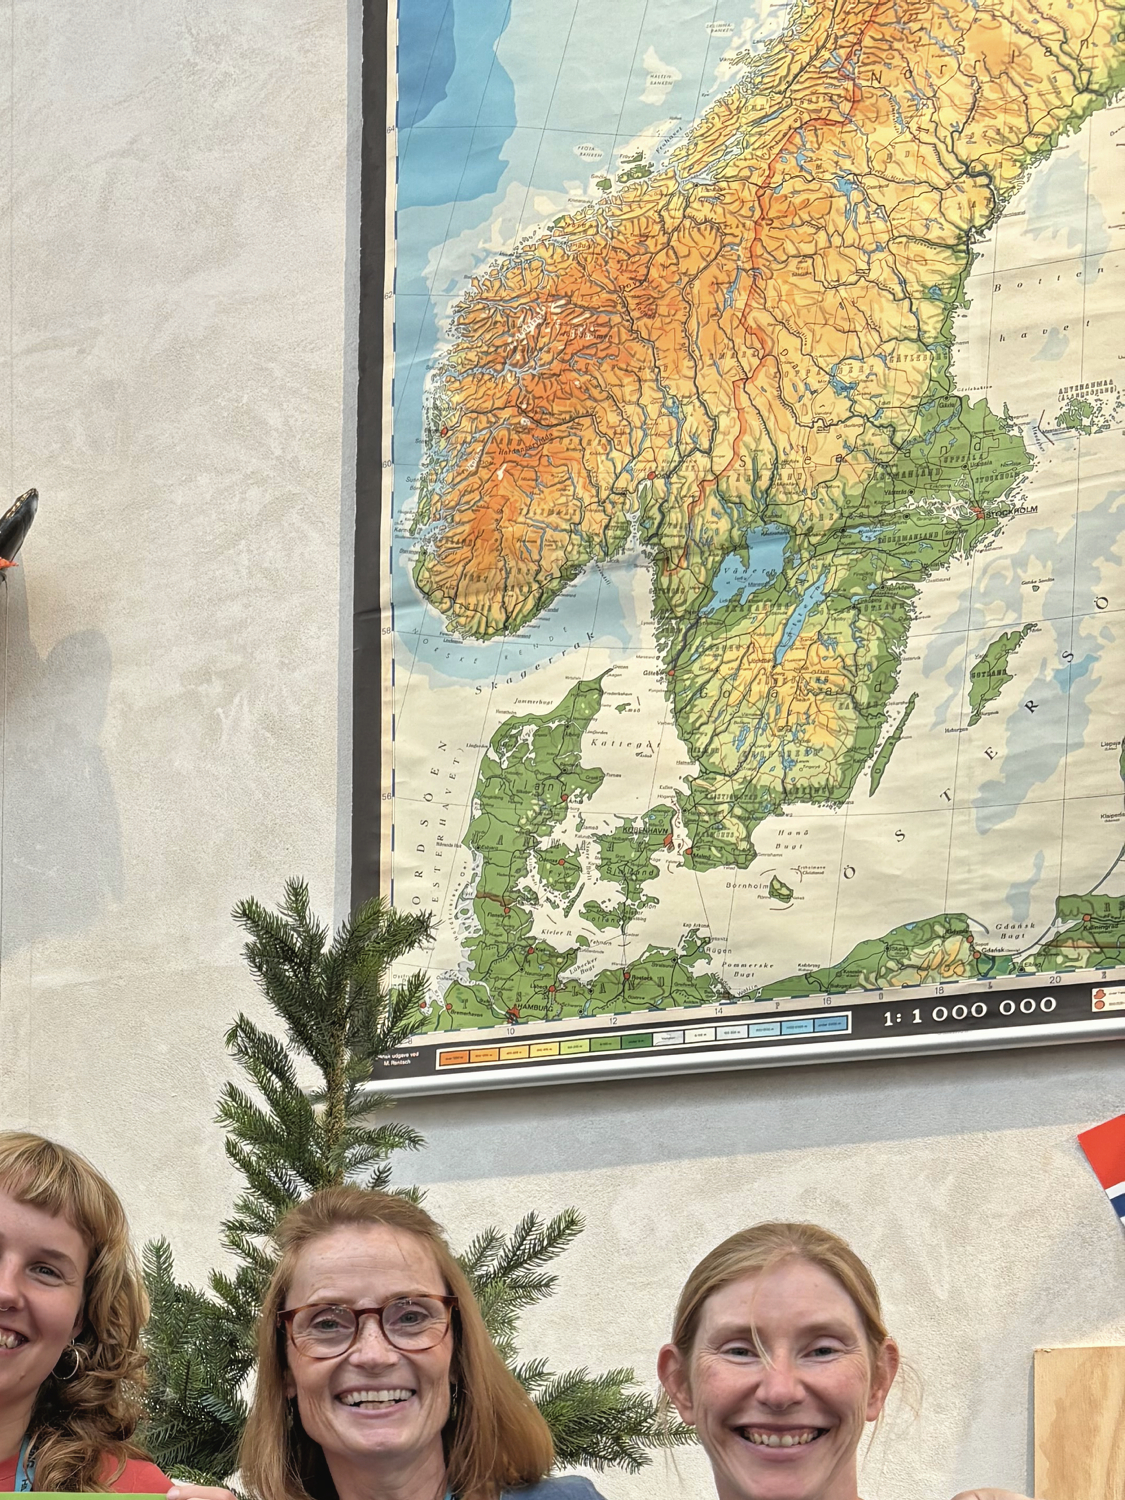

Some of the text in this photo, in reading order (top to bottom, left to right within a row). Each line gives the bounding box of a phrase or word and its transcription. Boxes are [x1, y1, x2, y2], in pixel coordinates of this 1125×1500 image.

[1000, 320, 1091, 342] havet
[986, 505, 1039, 519] STOCKHOLM
[382, 626, 392, 636] 58
[475, 632, 595, 695] Skagerrak
[381, 794, 392, 802] 56
[778, 829, 809, 837] Hanö
[726, 881, 770, 890] Bornholm
[721, 961, 774, 969] Pommerske
[823, 998, 832, 1006] 16
[935, 987, 944, 995] 18
[1049, 976, 1061, 984] 20
[517, 1003, 554, 1012] HAMBURG
[932, 1002, 987, 1021] 000
[999, 997, 1057, 1015] 000
